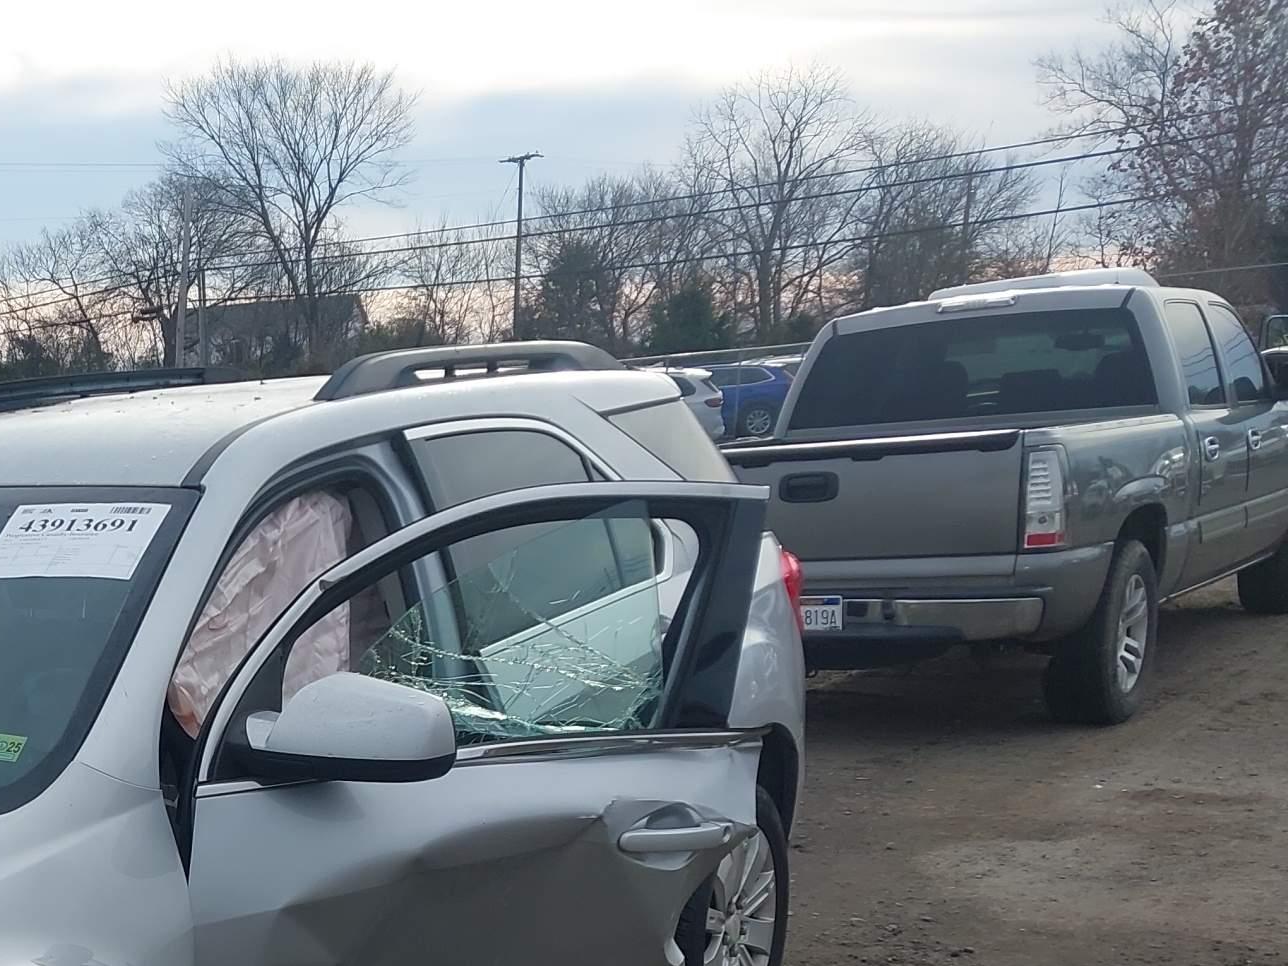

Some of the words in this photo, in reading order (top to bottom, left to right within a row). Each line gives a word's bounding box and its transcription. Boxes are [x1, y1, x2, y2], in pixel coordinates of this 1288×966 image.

[18, 518, 138, 534] 43913691
[804, 609, 837, 626] 819A
[6, 741, 23, 754] 25
